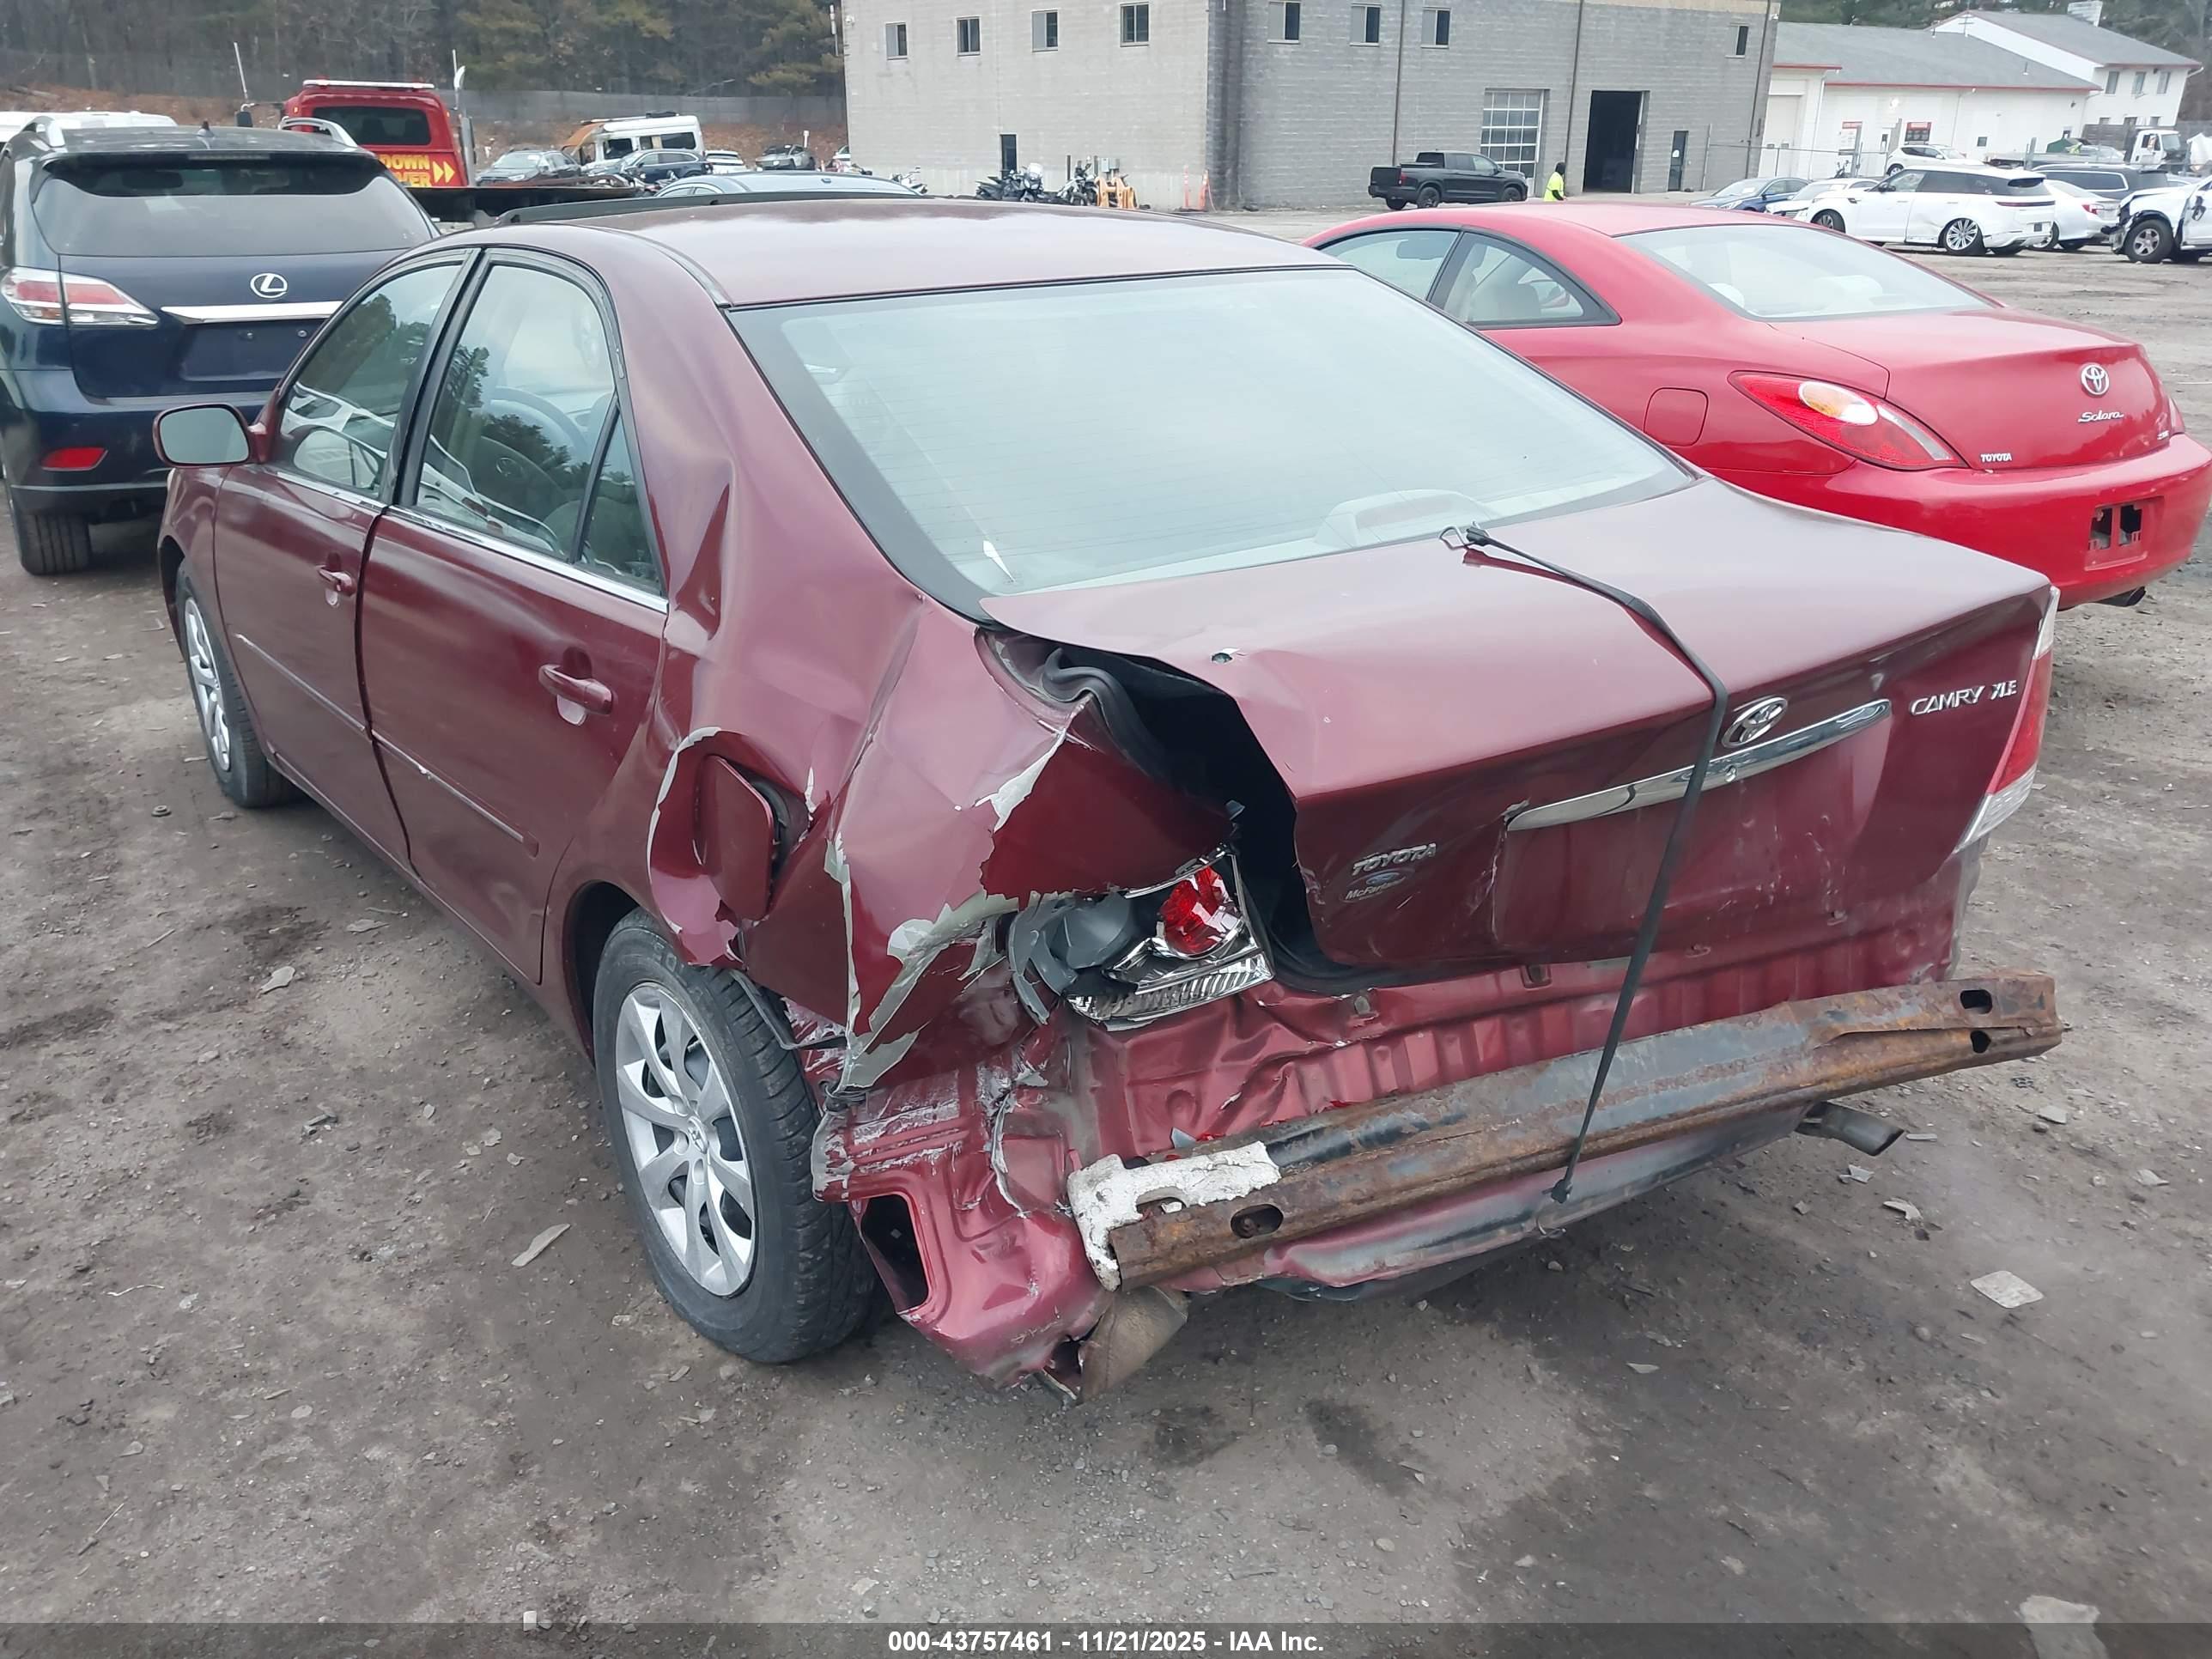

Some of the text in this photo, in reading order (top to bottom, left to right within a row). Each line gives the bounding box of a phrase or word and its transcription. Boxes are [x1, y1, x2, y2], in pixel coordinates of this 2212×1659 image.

[379, 154, 430, 169] DOWN
[2078, 410, 2124, 422] Solara
[1980, 453, 2013, 464] TOYOTA
[1911, 685, 1985, 715] CAMRY
[1352, 842, 1437, 876] TOYOTA
